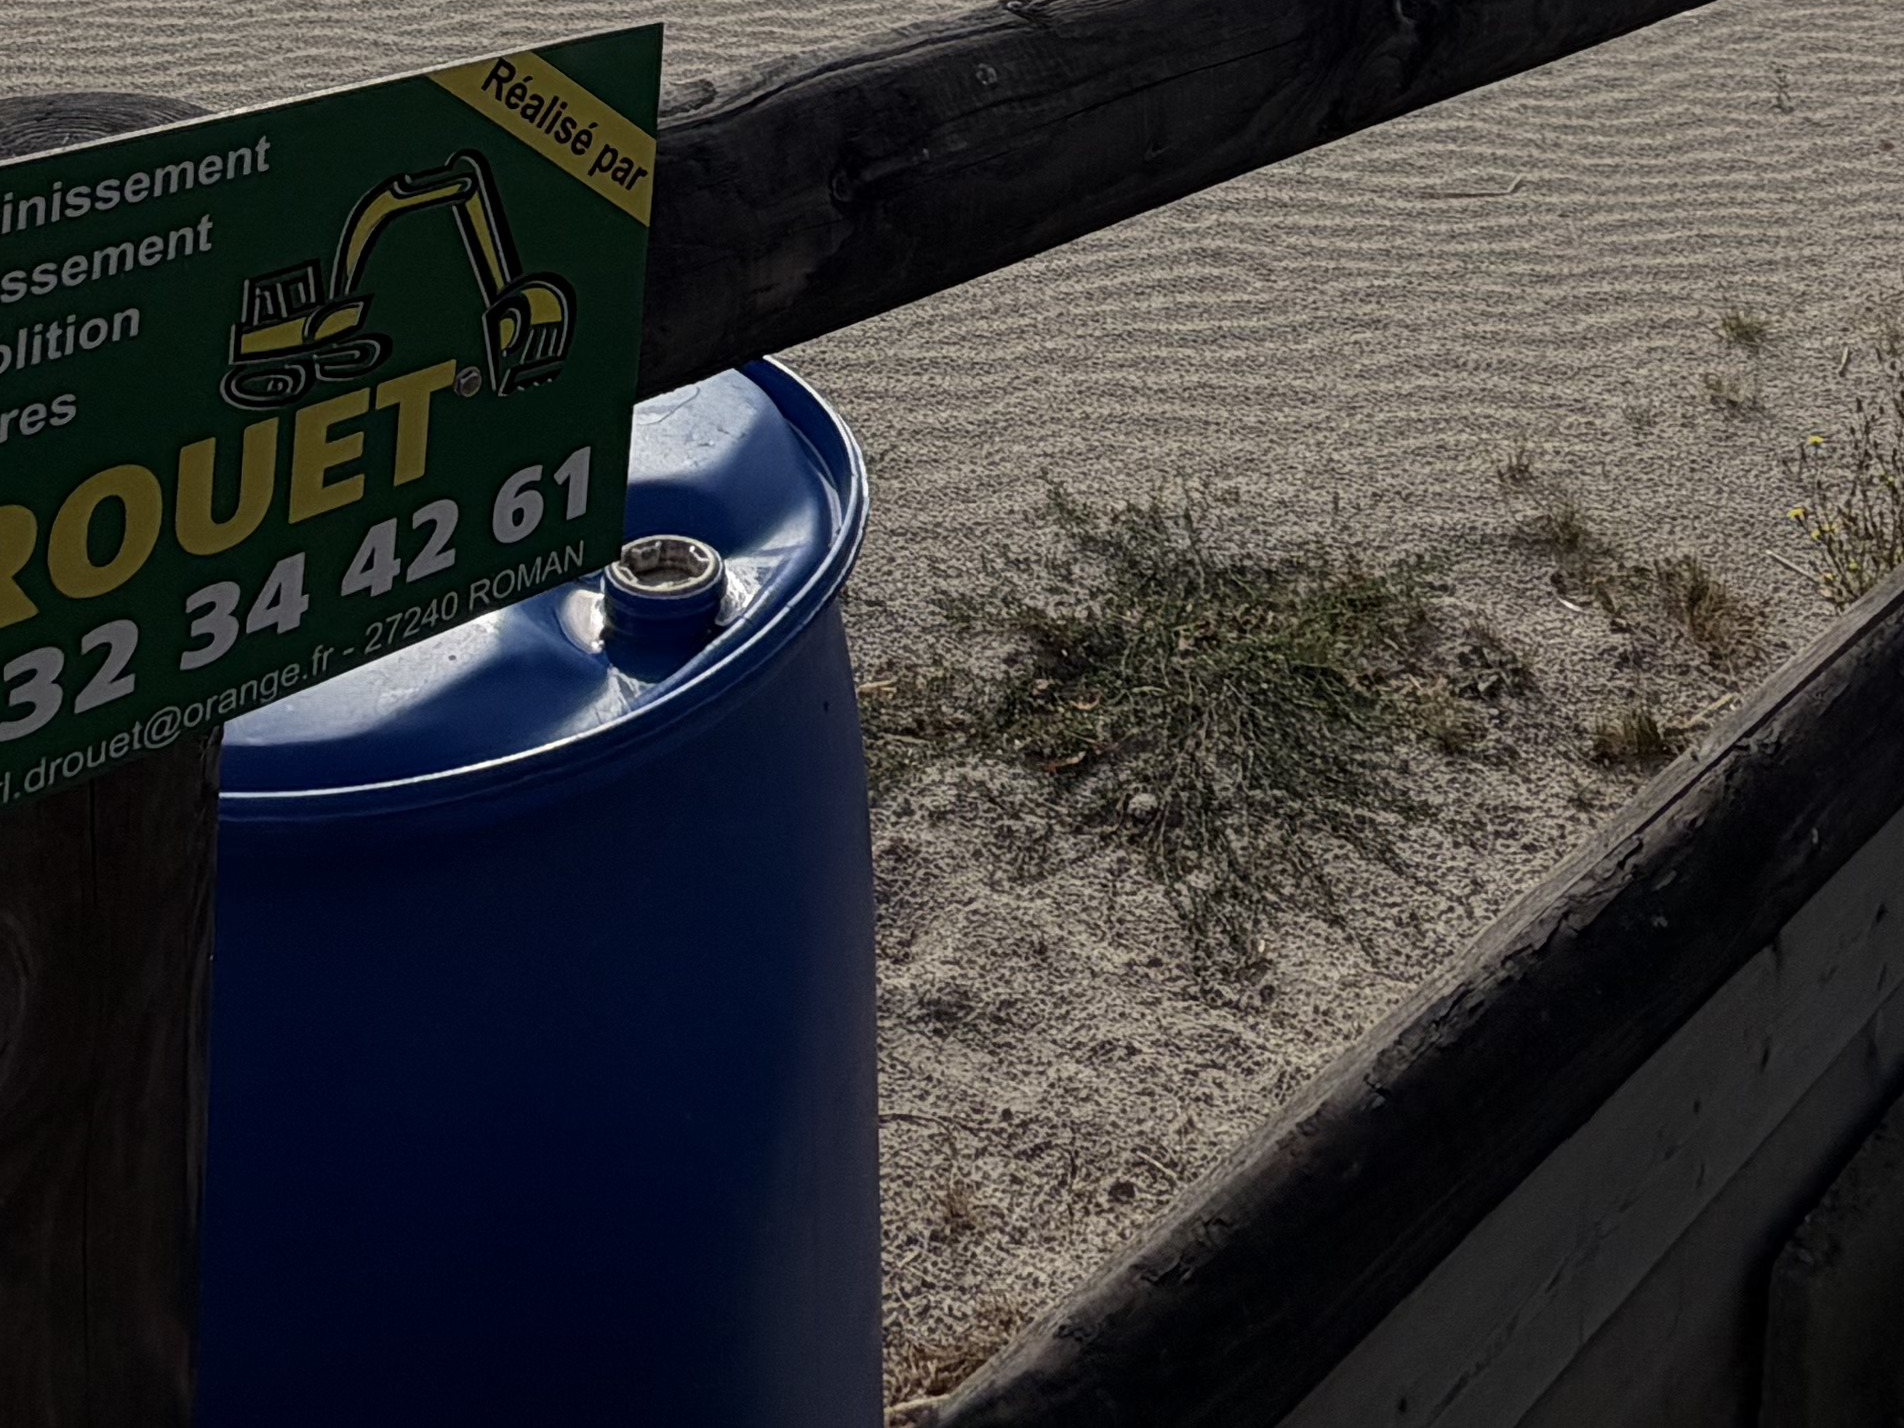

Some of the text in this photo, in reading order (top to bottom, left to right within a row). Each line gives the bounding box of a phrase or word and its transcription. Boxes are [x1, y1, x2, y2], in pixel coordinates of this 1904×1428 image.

[482, 58, 648, 190] Réalisé par
[179, 551, 311, 672] 34
[339, 498, 460, 598] 42
[491, 445, 592, 544] 61
[363, 590, 459, 655] 27240
[467, 539, 585, 613] ROMAN
